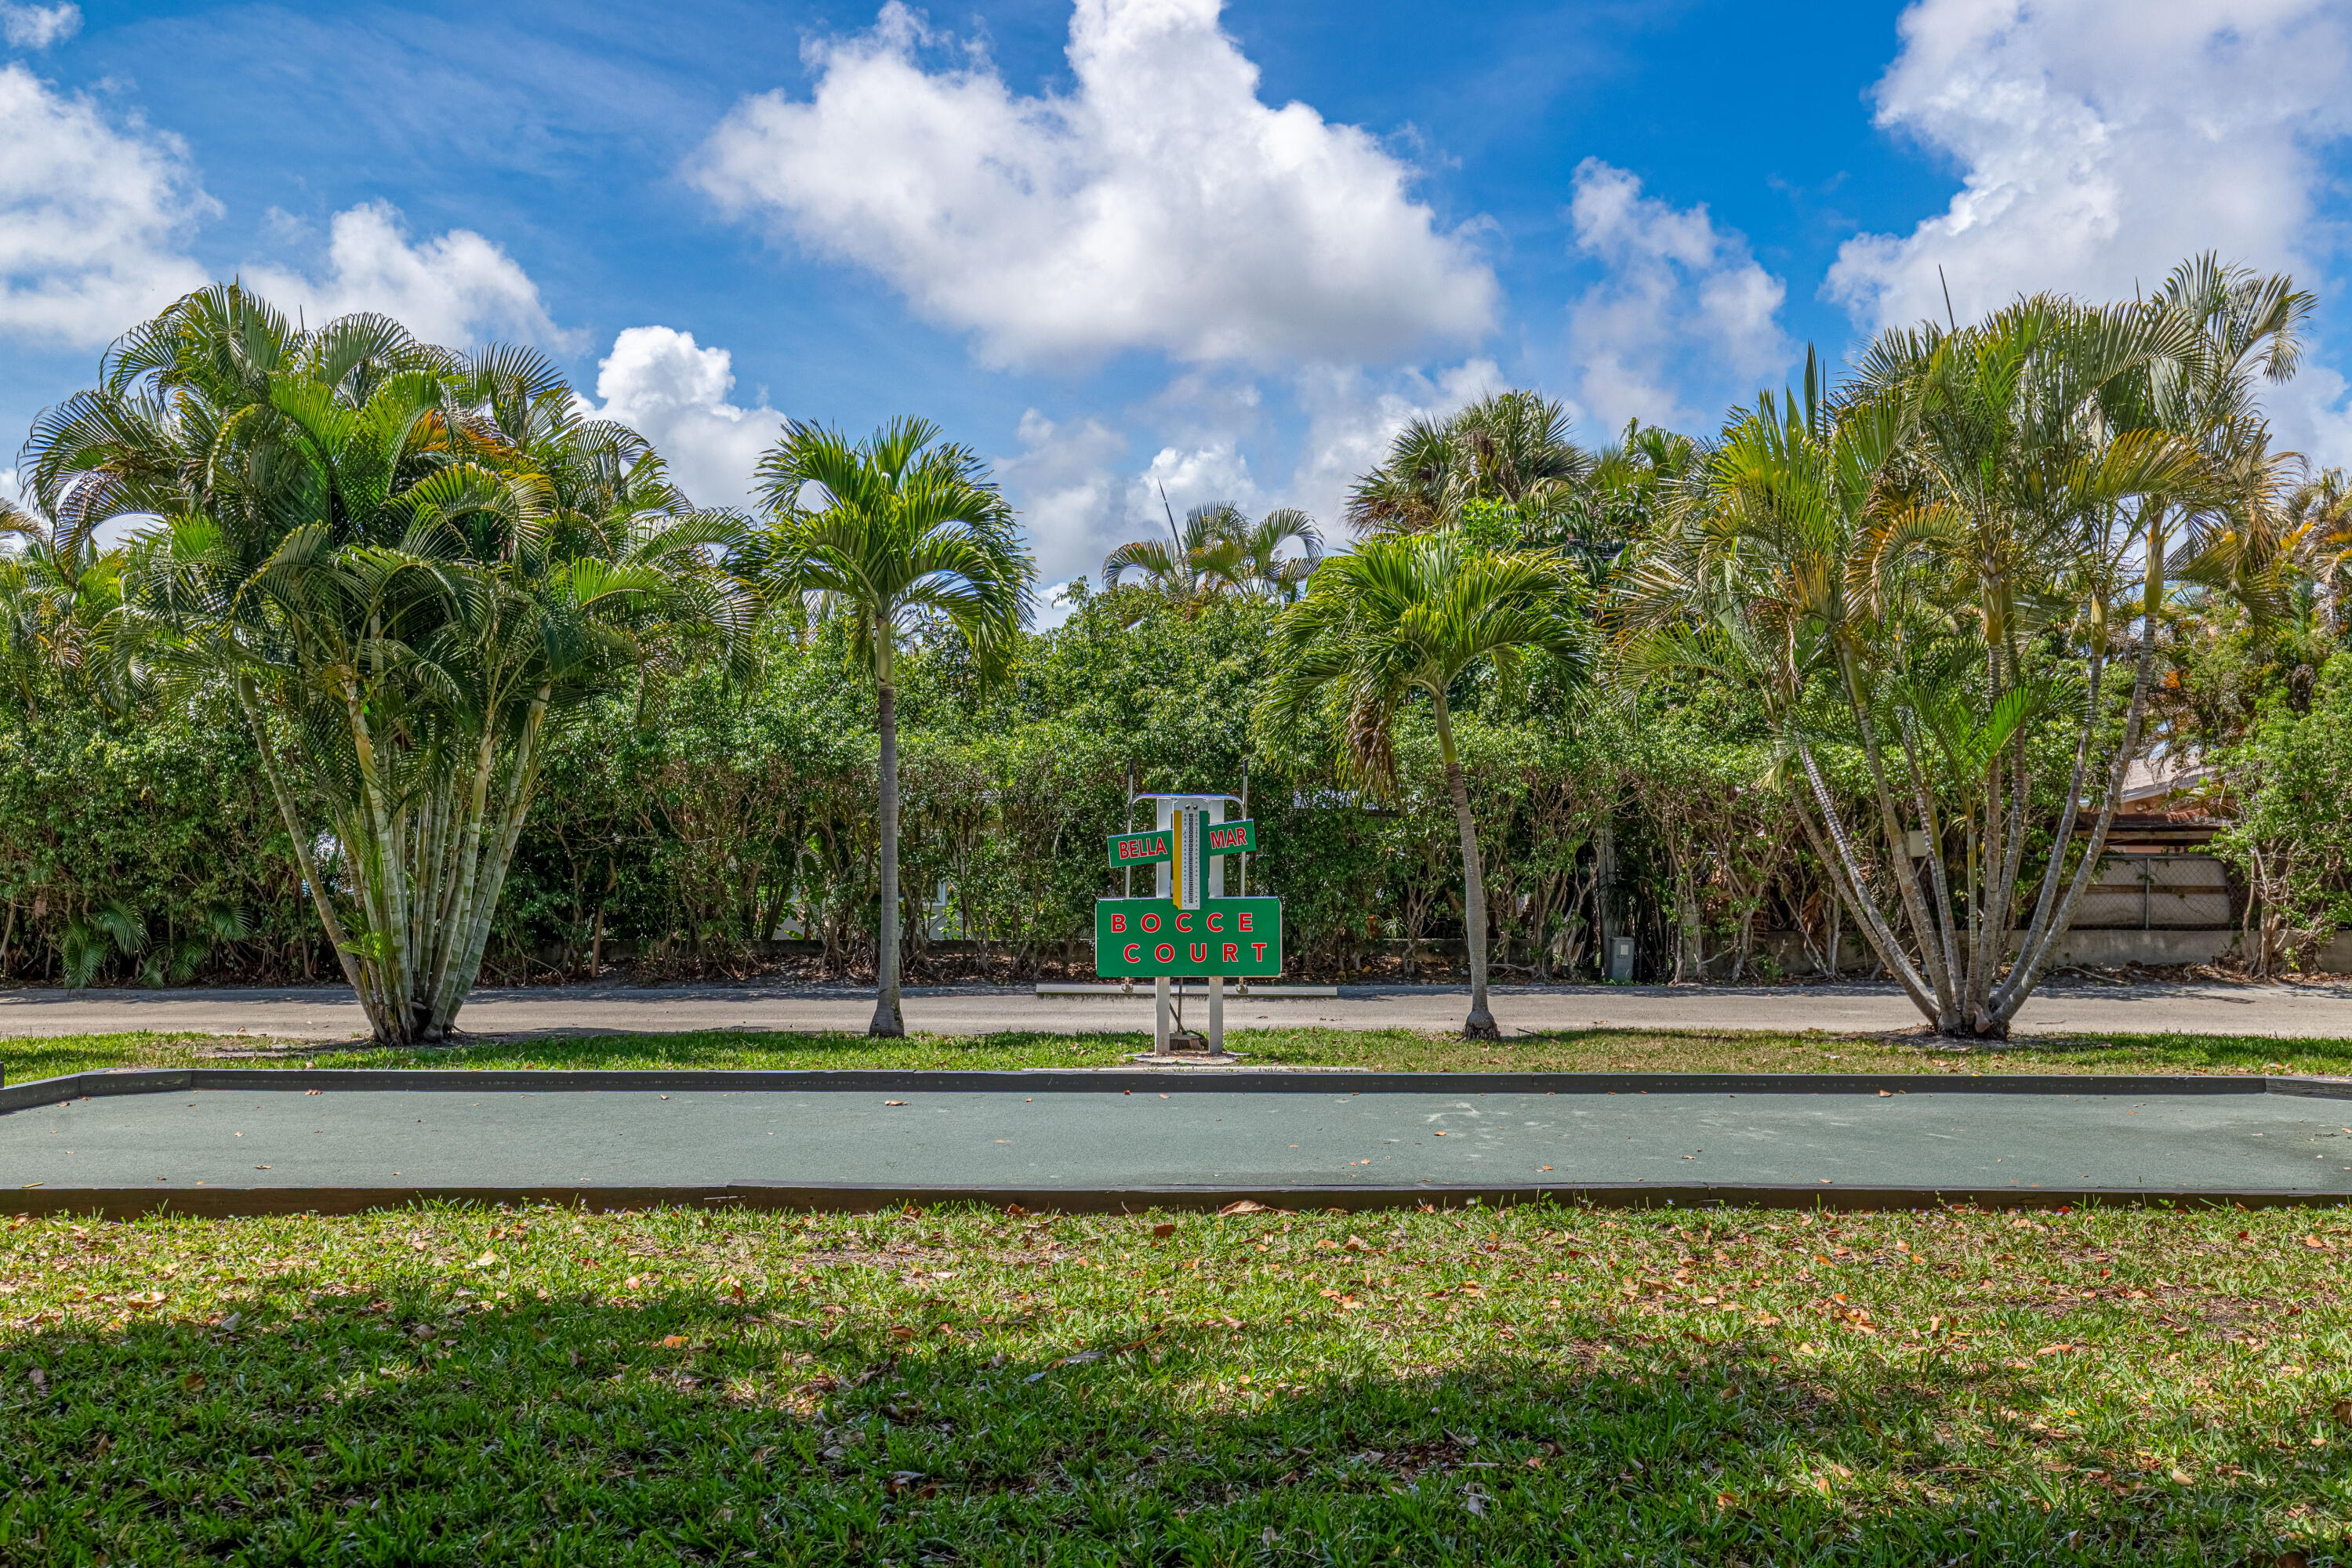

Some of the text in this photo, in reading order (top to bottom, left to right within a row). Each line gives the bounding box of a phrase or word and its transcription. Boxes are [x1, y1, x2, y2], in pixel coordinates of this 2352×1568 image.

[1119, 827, 1248, 860] BELLA MAR
[1111, 912, 1254, 933] BOCCE
[1123, 942, 1268, 964] COURT
